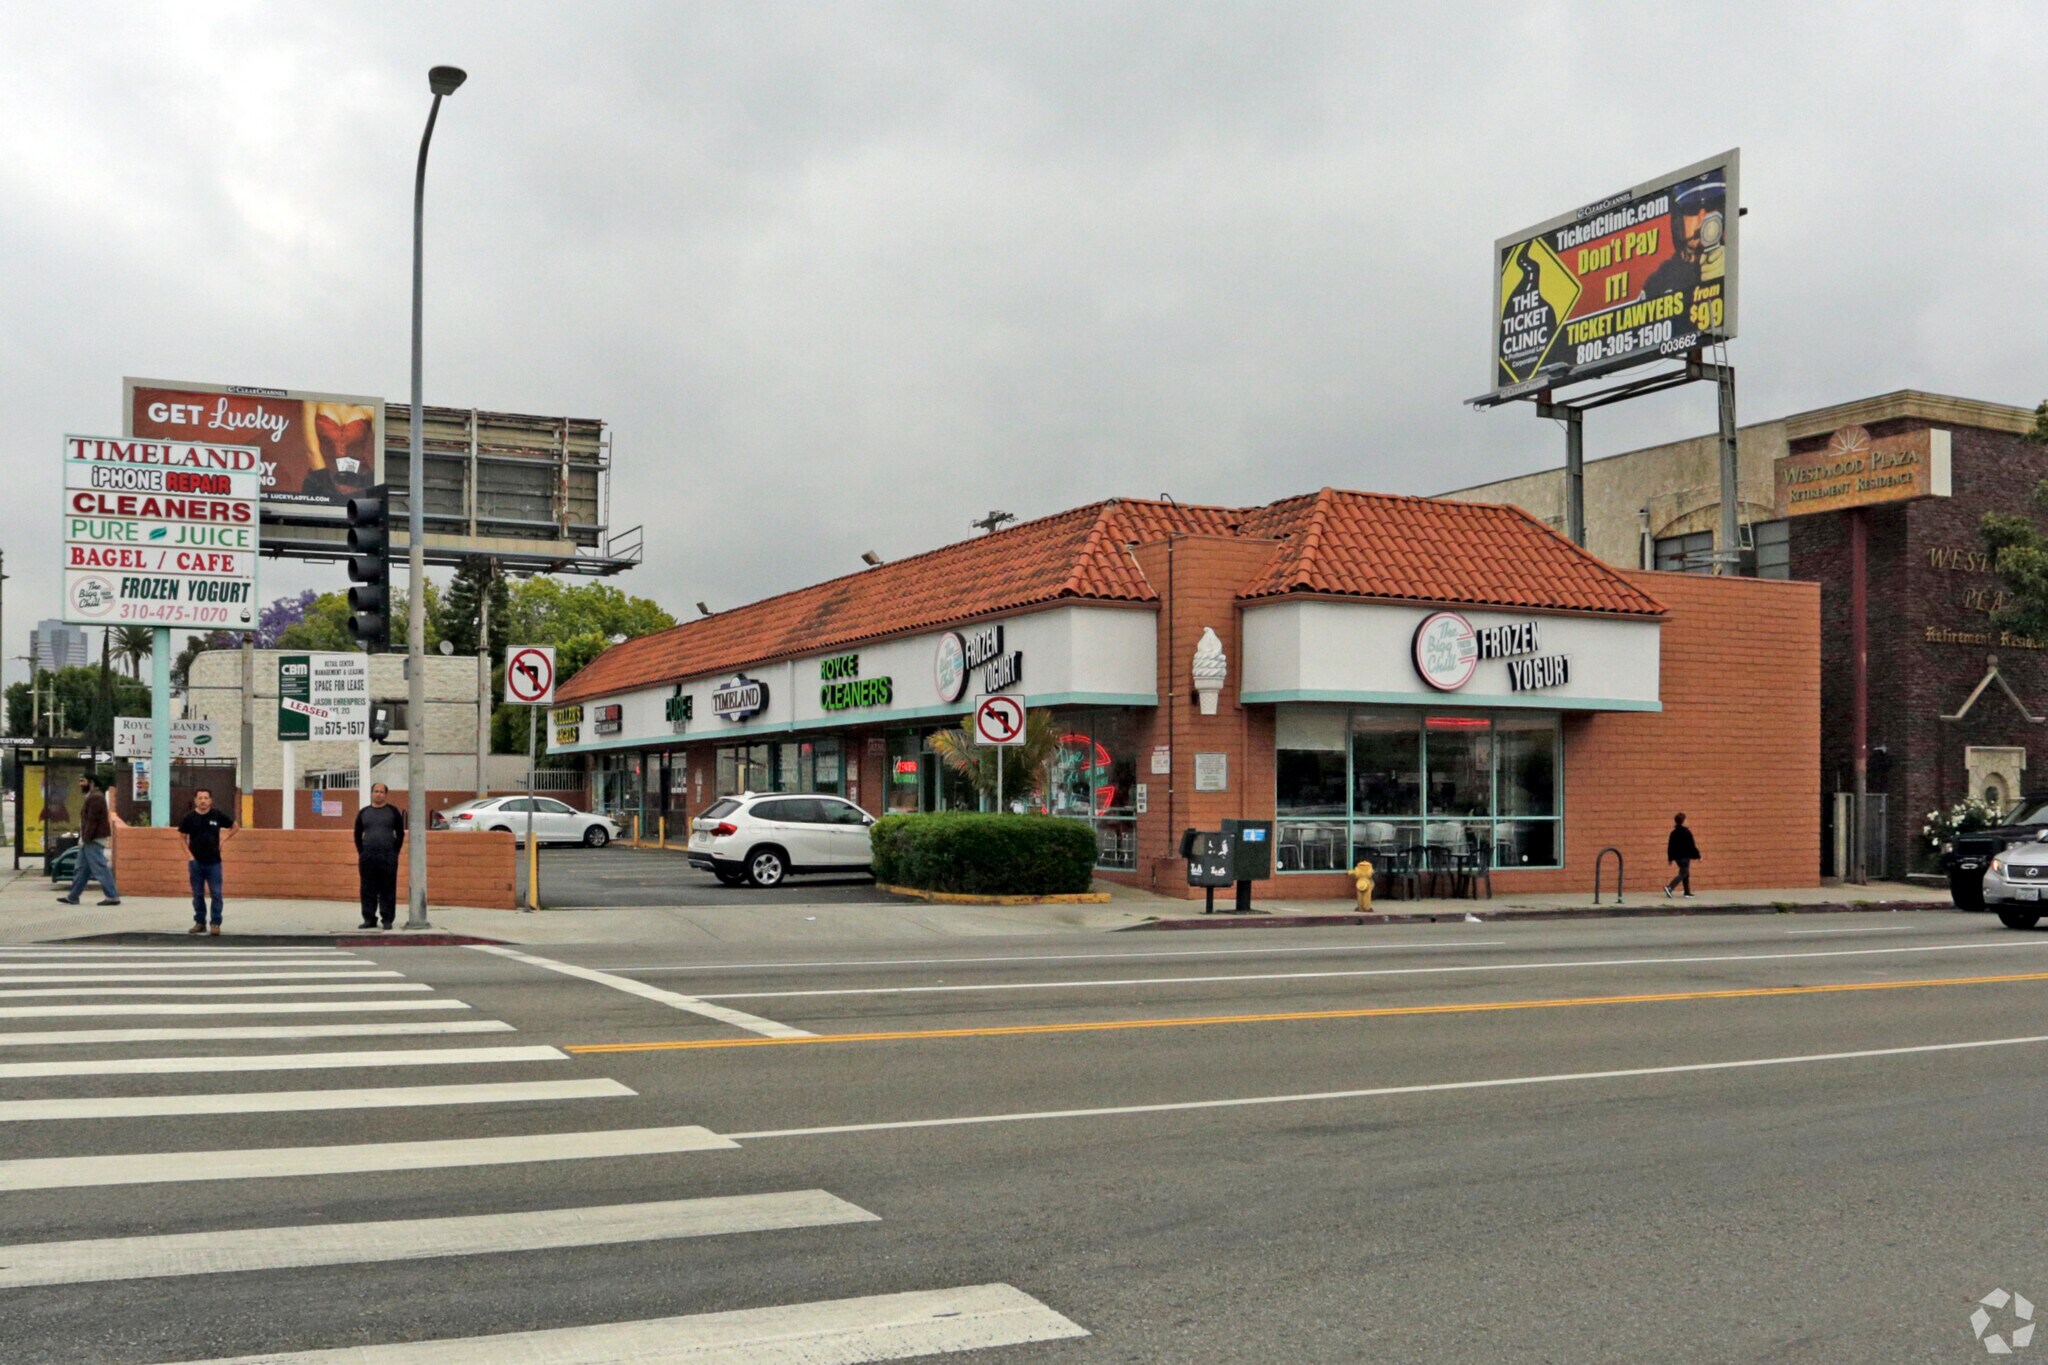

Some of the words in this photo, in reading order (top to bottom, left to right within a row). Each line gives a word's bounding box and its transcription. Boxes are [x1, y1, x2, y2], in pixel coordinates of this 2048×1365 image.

[1556, 195, 1669, 251] TicketClinic.com
[1578, 237, 1622, 276] Don't
[1625, 227, 1660, 260] Pay
[1512, 289, 1540, 314] THE
[1605, 271, 1629, 303] IT!
[1693, 283, 1720, 302] from
[1502, 306, 1549, 336] TICKET
[1566, 311, 1614, 346] TICKET
[1615, 291, 1684, 333] LAWYERS
[1690, 298, 1724, 331] $99
[1502, 326, 1548, 354] CLINIC
[1576, 319, 1673, 365] 800-305-1500
[1659, 333, 1698, 356] 003662
[147, 402, 204, 425] GET
[207, 397, 290, 443] Lucky
[69, 438, 256, 471] TIMELAND
[1783, 459, 1865, 485] WESTWOOD
[1870, 450, 1920, 470] PLAZA
[91, 465, 163, 491] iPHONE
[165, 471, 231, 495] REPAIR
[1790, 482, 1852, 502] RETIREMENT
[1856, 473, 1914, 491] RESIDENCE
[72, 492, 252, 523] CLEANERS
[270, 493, 330, 502] LUCKYLADYLA.COM
[71, 519, 139, 541] PURE
[174, 525, 250, 548] JUICE
[70, 546, 147, 569] BAGEL
[176, 552, 235, 573] CAFE
[88, 581, 101, 590] The
[119, 577, 180, 601] FROZEN
[188, 580, 252, 604] YOGURT
[119, 603, 229, 622] 310-475-1070
[1438, 621, 1459, 639] The
[1479, 621, 1541, 660] FROZEN
[1925, 625, 1992, 643] Retirement
[965, 626, 1002, 670] FROZEN
[820, 654, 857, 681] ROYCE
[982, 650, 1020, 694] YOGURT
[1511, 654, 1574, 691] YOGURT
[314, 680, 332, 692] SPACE
[334, 680, 345, 691] FOR
[347, 679, 365, 691] LEASE
[712, 687, 760, 712] TIMELAND
[820, 677, 892, 711] CLEANERS
[290, 700, 329, 719] LEASED
[325, 721, 366, 736] 575-1517
